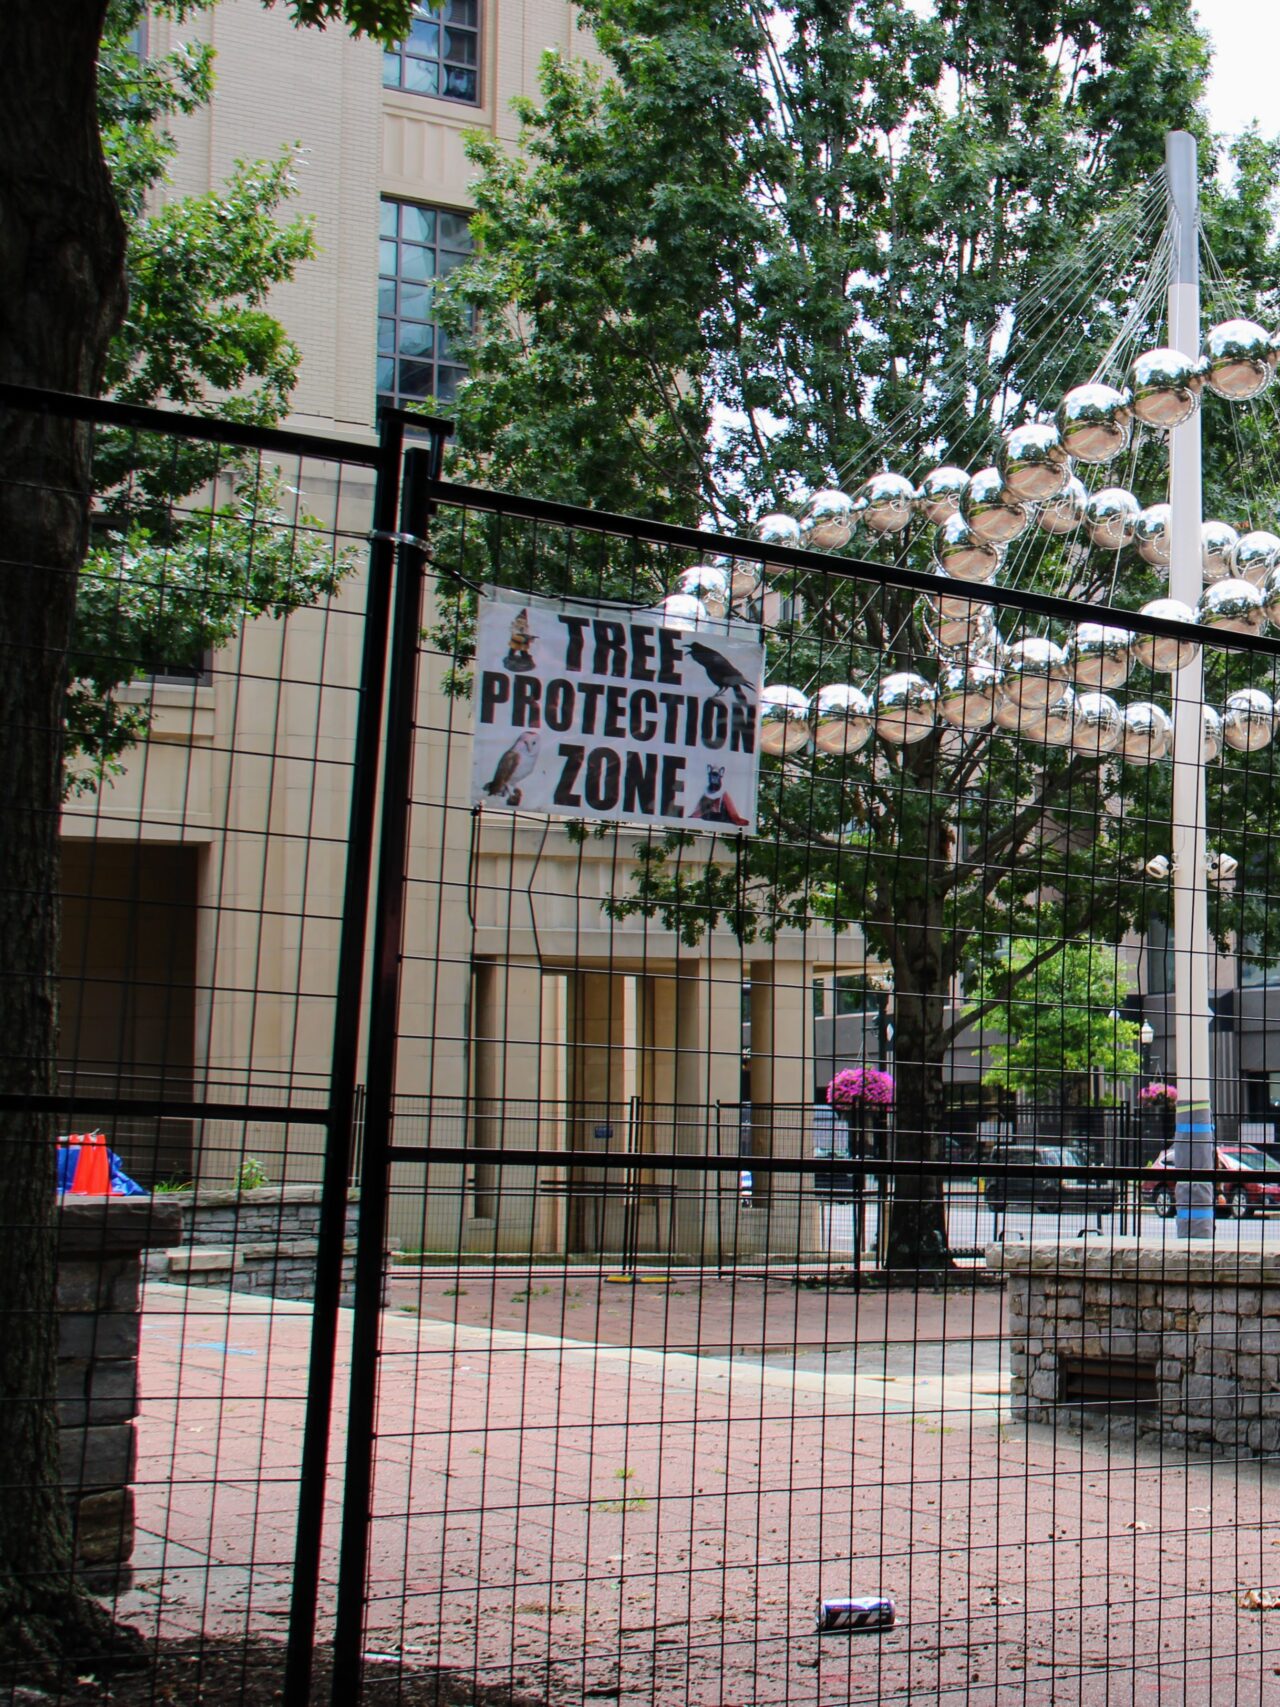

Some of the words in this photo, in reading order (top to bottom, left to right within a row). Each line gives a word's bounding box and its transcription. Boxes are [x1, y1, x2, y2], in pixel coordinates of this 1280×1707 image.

[558, 615, 682, 685] TREE
[480, 671, 757, 753] PROTECTION
[553, 743, 686, 818] ZONE
